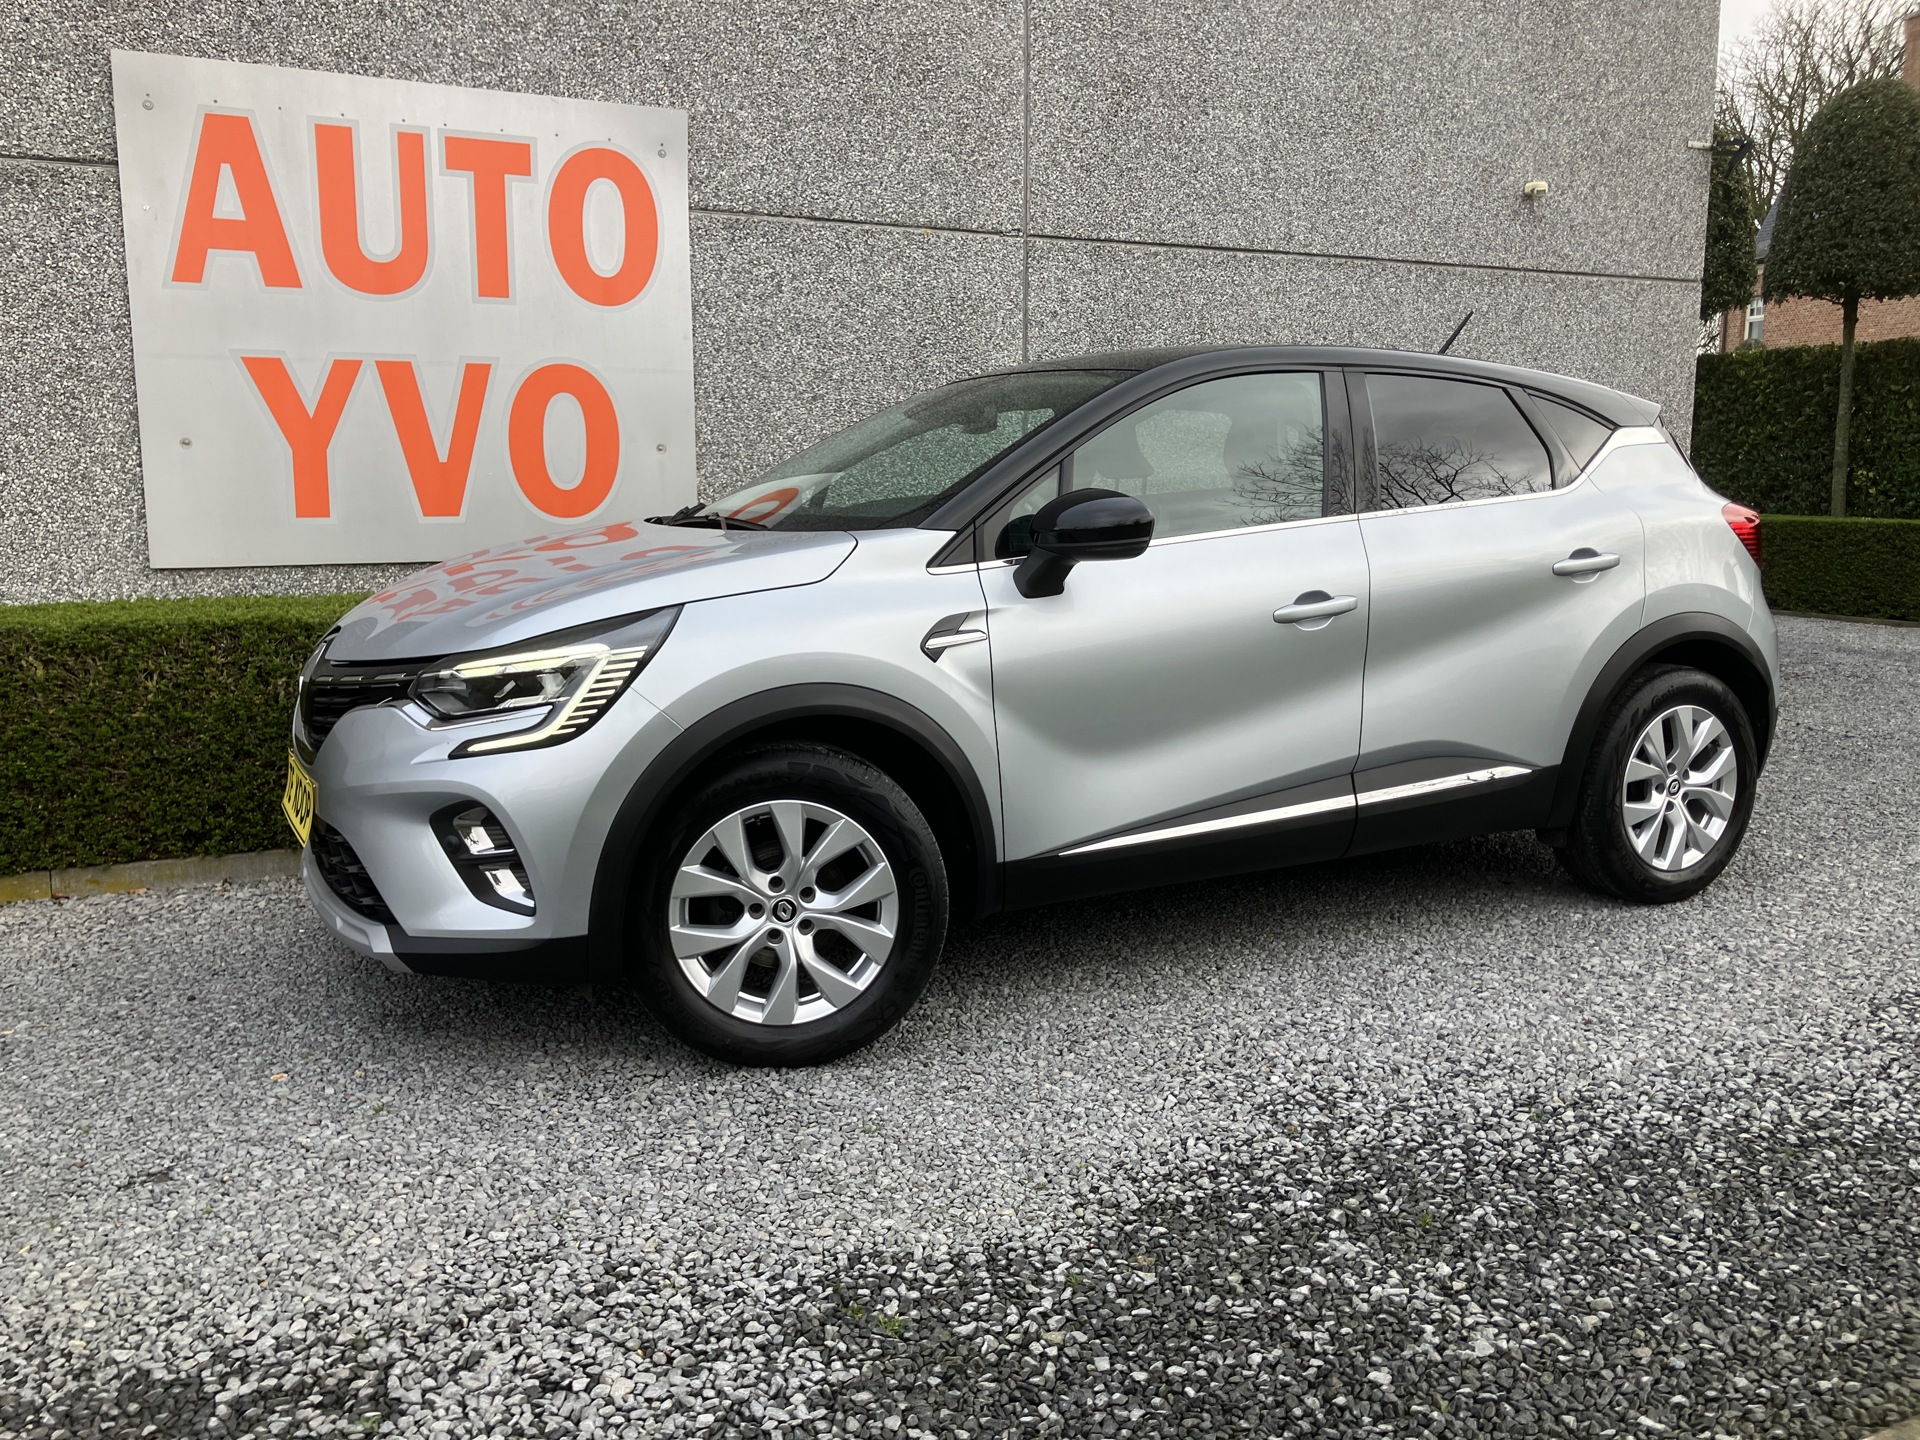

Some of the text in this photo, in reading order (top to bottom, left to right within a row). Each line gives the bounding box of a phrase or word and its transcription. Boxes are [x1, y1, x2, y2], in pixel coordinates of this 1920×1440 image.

[171, 112, 659, 307] AUTO
[240, 355, 620, 519] YVO
[291, 775, 311, 829] KOOP
